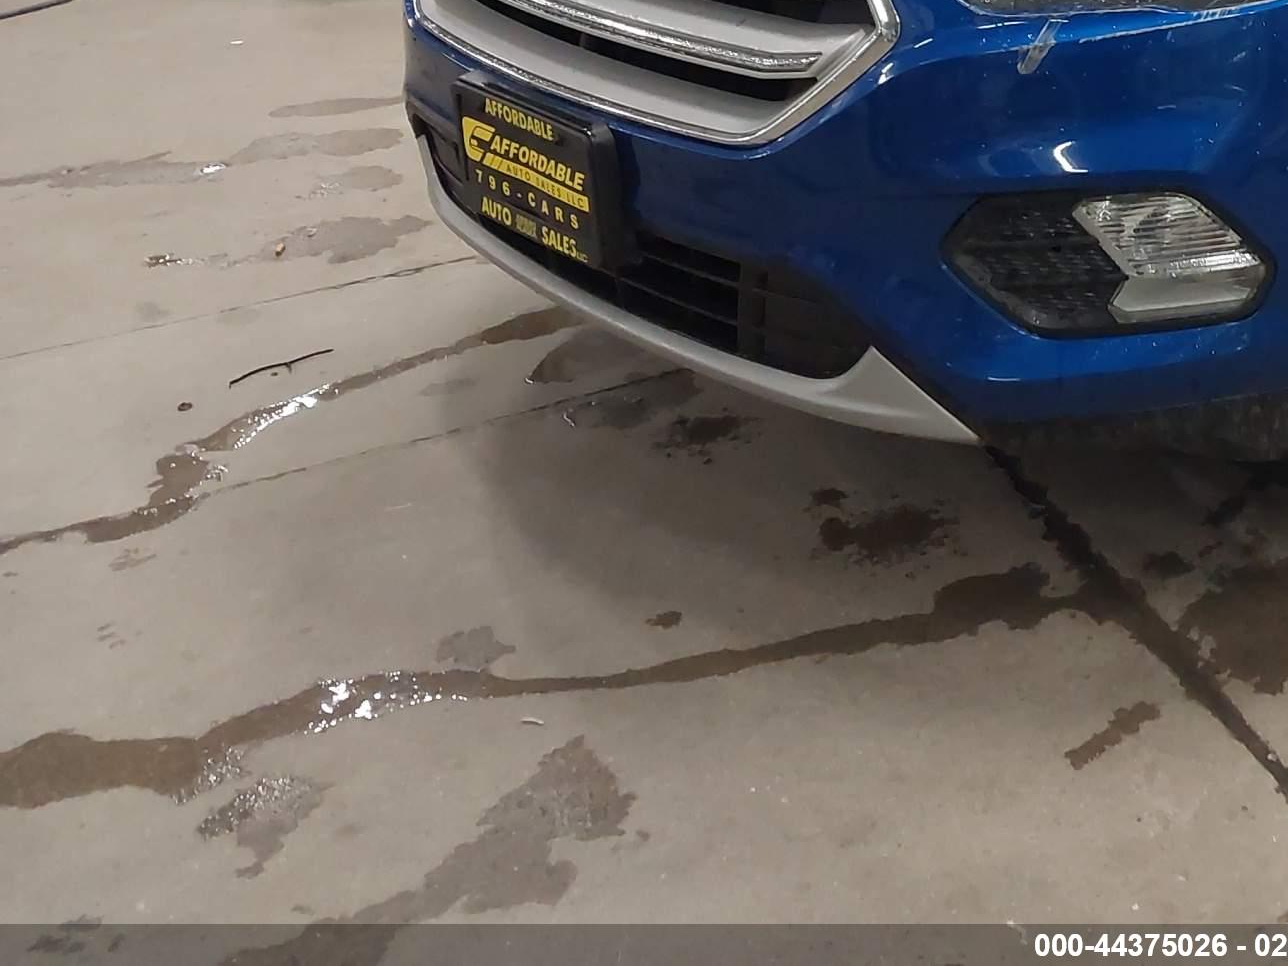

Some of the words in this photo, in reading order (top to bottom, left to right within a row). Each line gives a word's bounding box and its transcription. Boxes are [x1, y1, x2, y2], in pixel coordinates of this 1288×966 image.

[485, 97, 554, 141] AFFORDABLE
[490, 135, 585, 191] AFFORDABLE
[506, 163, 531, 181] AUTO
[481, 196, 512, 226] AUTO
[541, 225, 577, 258] SALES
